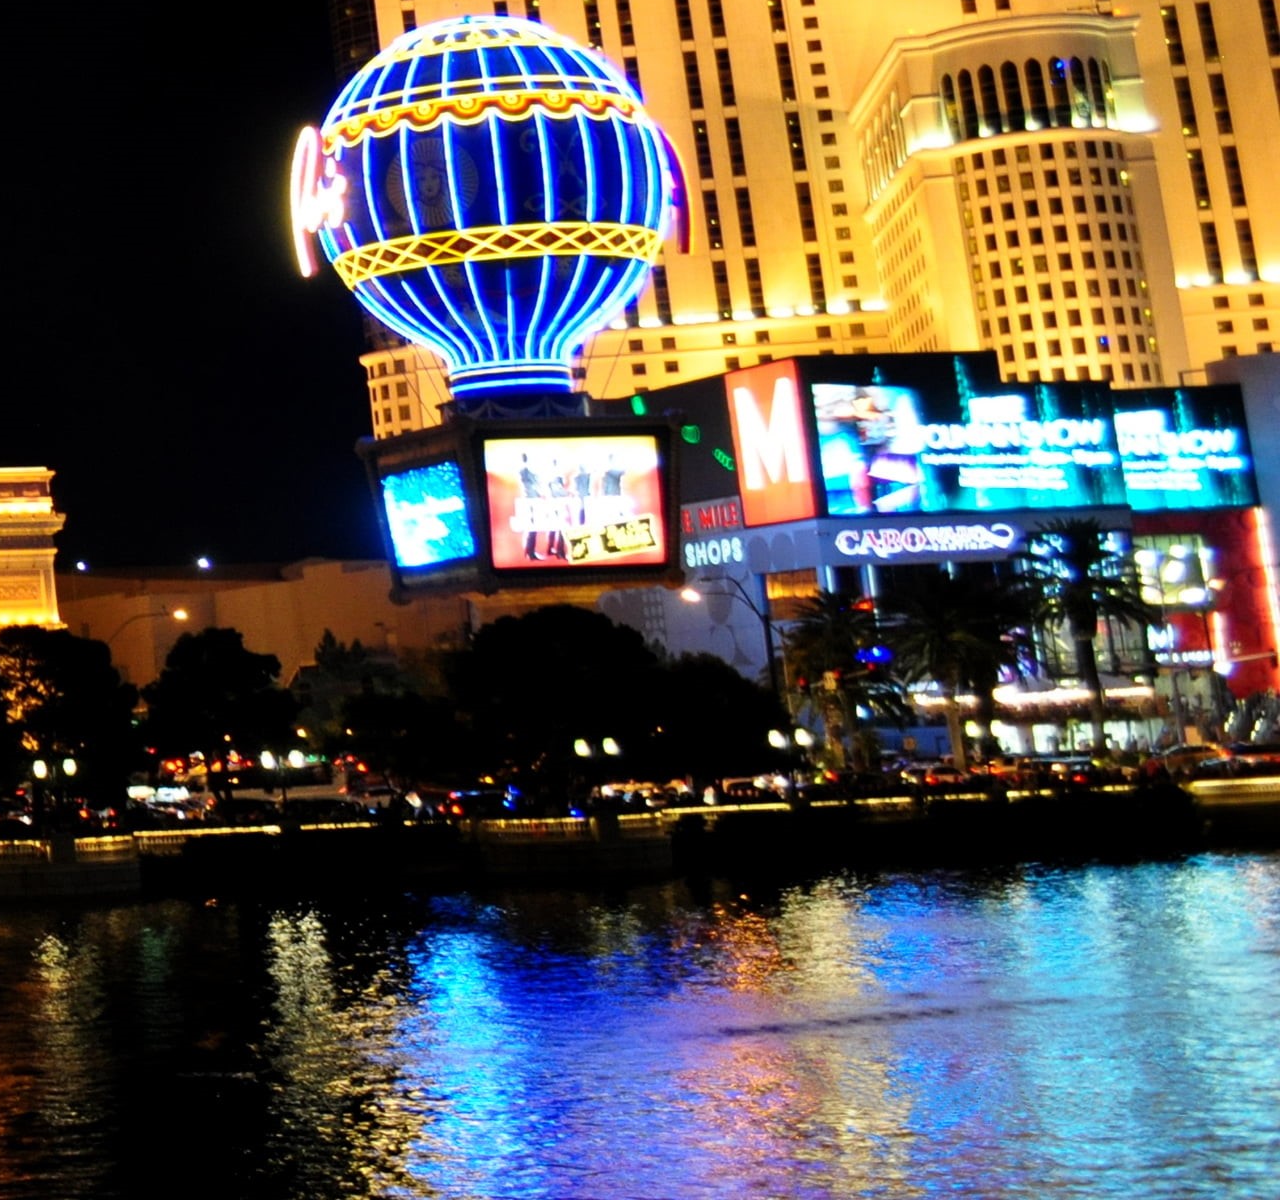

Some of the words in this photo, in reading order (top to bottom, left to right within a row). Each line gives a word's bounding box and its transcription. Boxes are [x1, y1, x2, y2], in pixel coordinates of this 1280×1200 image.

[733, 377, 807, 491] M
[698, 501, 739, 530] MILE
[684, 536, 744, 568] SHOPS
